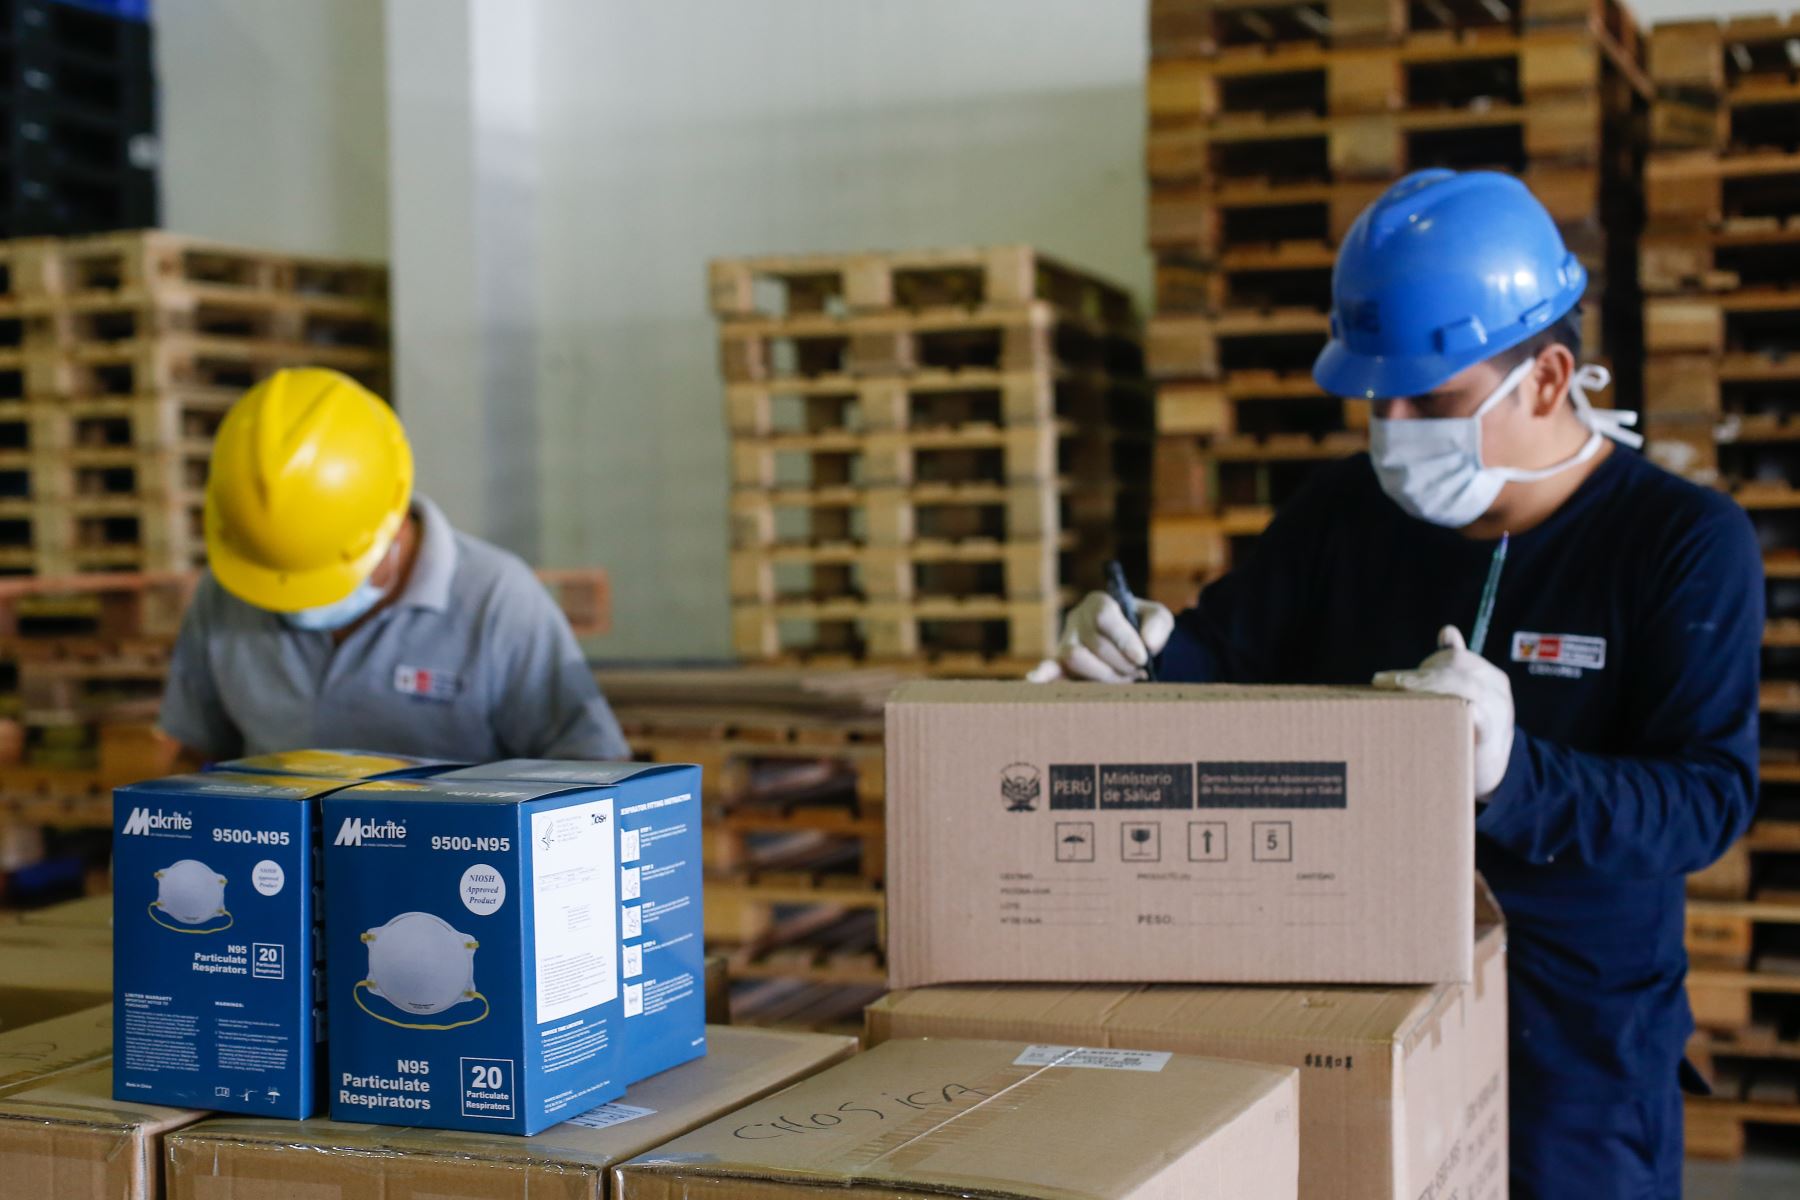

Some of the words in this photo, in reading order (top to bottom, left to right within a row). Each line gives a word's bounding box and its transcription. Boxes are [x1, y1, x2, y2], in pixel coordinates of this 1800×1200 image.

[1103, 772, 1172, 786] Ministerio
[1053, 779, 1093, 796] PERÚ
[1103, 788, 1119, 802] de
[1123, 788, 1162, 802] Salud
[122, 807, 192, 836] Makrite
[212, 828, 290, 846] 9500-N95
[334, 817, 407, 847] Makrite
[431, 836, 511, 852] 9500-N95
[469, 874, 495, 883] NIOSH
[466, 885, 499, 895] Approved
[469, 896, 496, 905] Product
[227, 944, 247, 954] N95
[259, 947, 278, 962] 20
[194, 952, 247, 964] Particulate
[192, 962, 247, 975] Respirators
[397, 1059, 429, 1075] N95
[342, 1072, 431, 1093] Particulate
[471, 1065, 503, 1090] 20
[339, 1090, 431, 1111] Respirators
[466, 1090, 510, 1101] Particulate
[465, 1100, 511, 1112] Respirators
